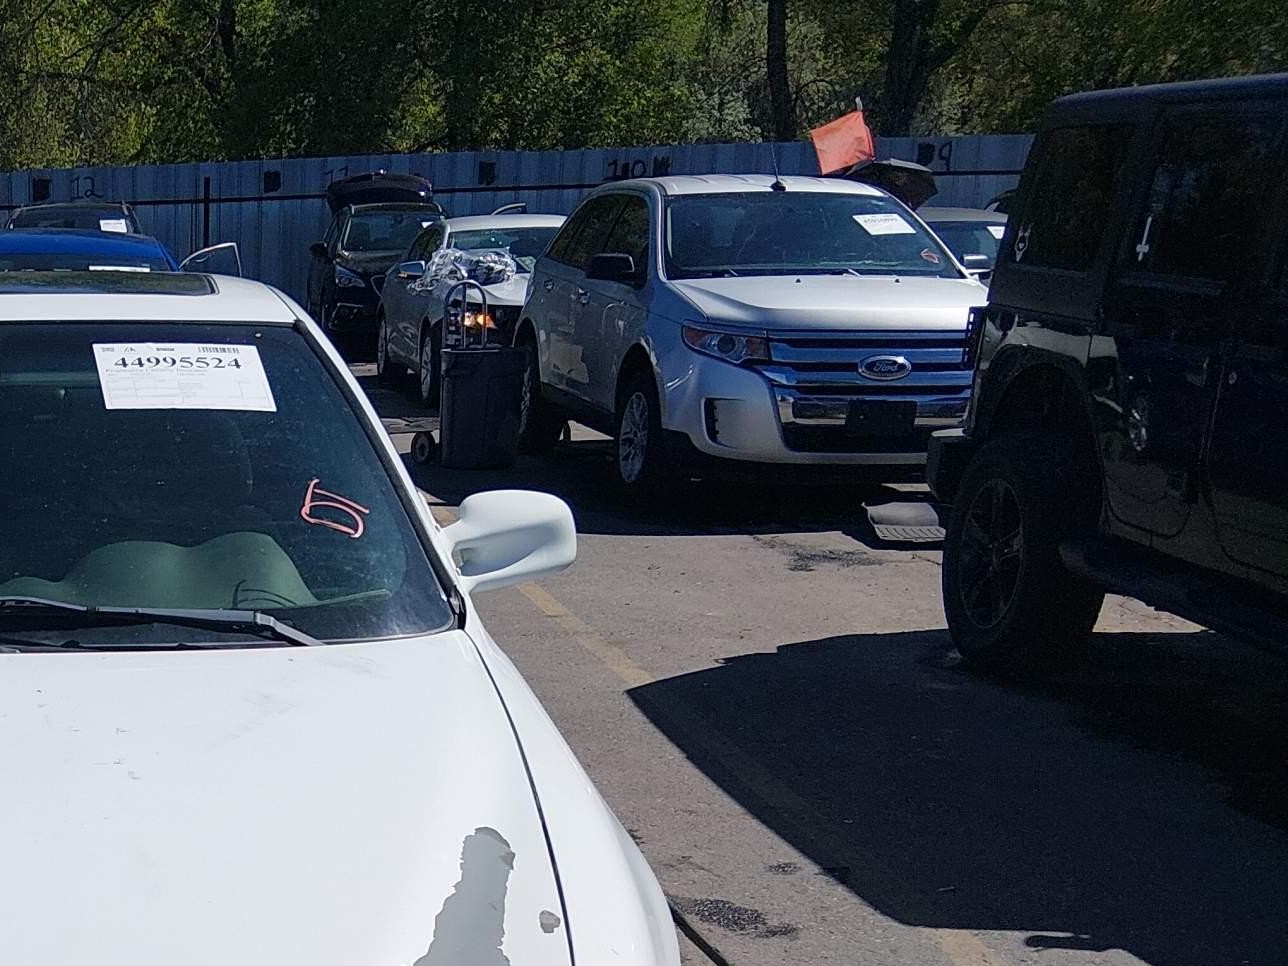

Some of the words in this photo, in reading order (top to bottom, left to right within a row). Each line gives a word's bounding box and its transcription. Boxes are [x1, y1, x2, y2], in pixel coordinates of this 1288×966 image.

[70, 175, 104, 200] 12
[114, 356, 242, 370] 44995524
[872, 361, 899, 372] Ford
